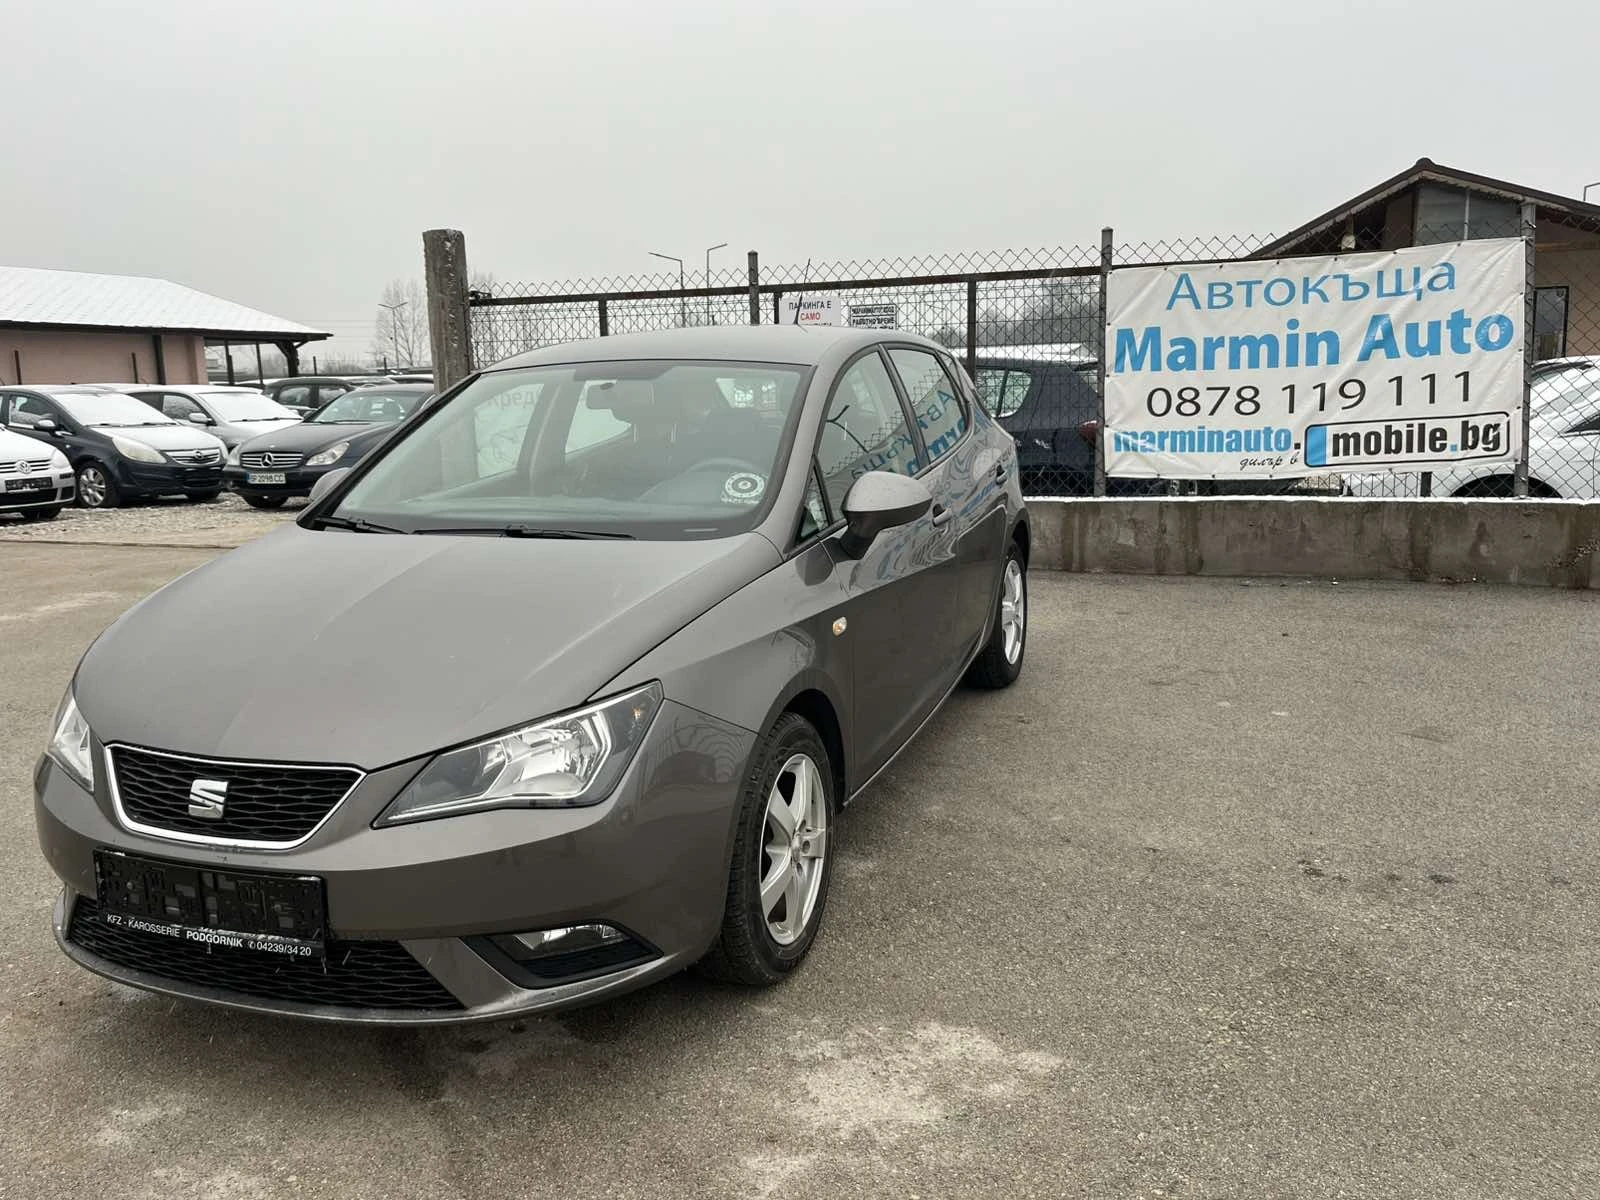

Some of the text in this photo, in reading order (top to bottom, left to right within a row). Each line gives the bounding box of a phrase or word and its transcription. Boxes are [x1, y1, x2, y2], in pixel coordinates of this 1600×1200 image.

[1166, 260, 1456, 312] Автокъща
[800, 312, 821, 321] САМО
[1113, 307, 1515, 375] Marmin Auto
[1146, 370, 1471, 418] 0878 119 111
[1332, 419, 1501, 458] mobile.bg
[106, 913, 122, 925] KFZ
[128, 919, 181, 938] KAROSSERIE
[186, 930, 243, 947] PODGORNIK
